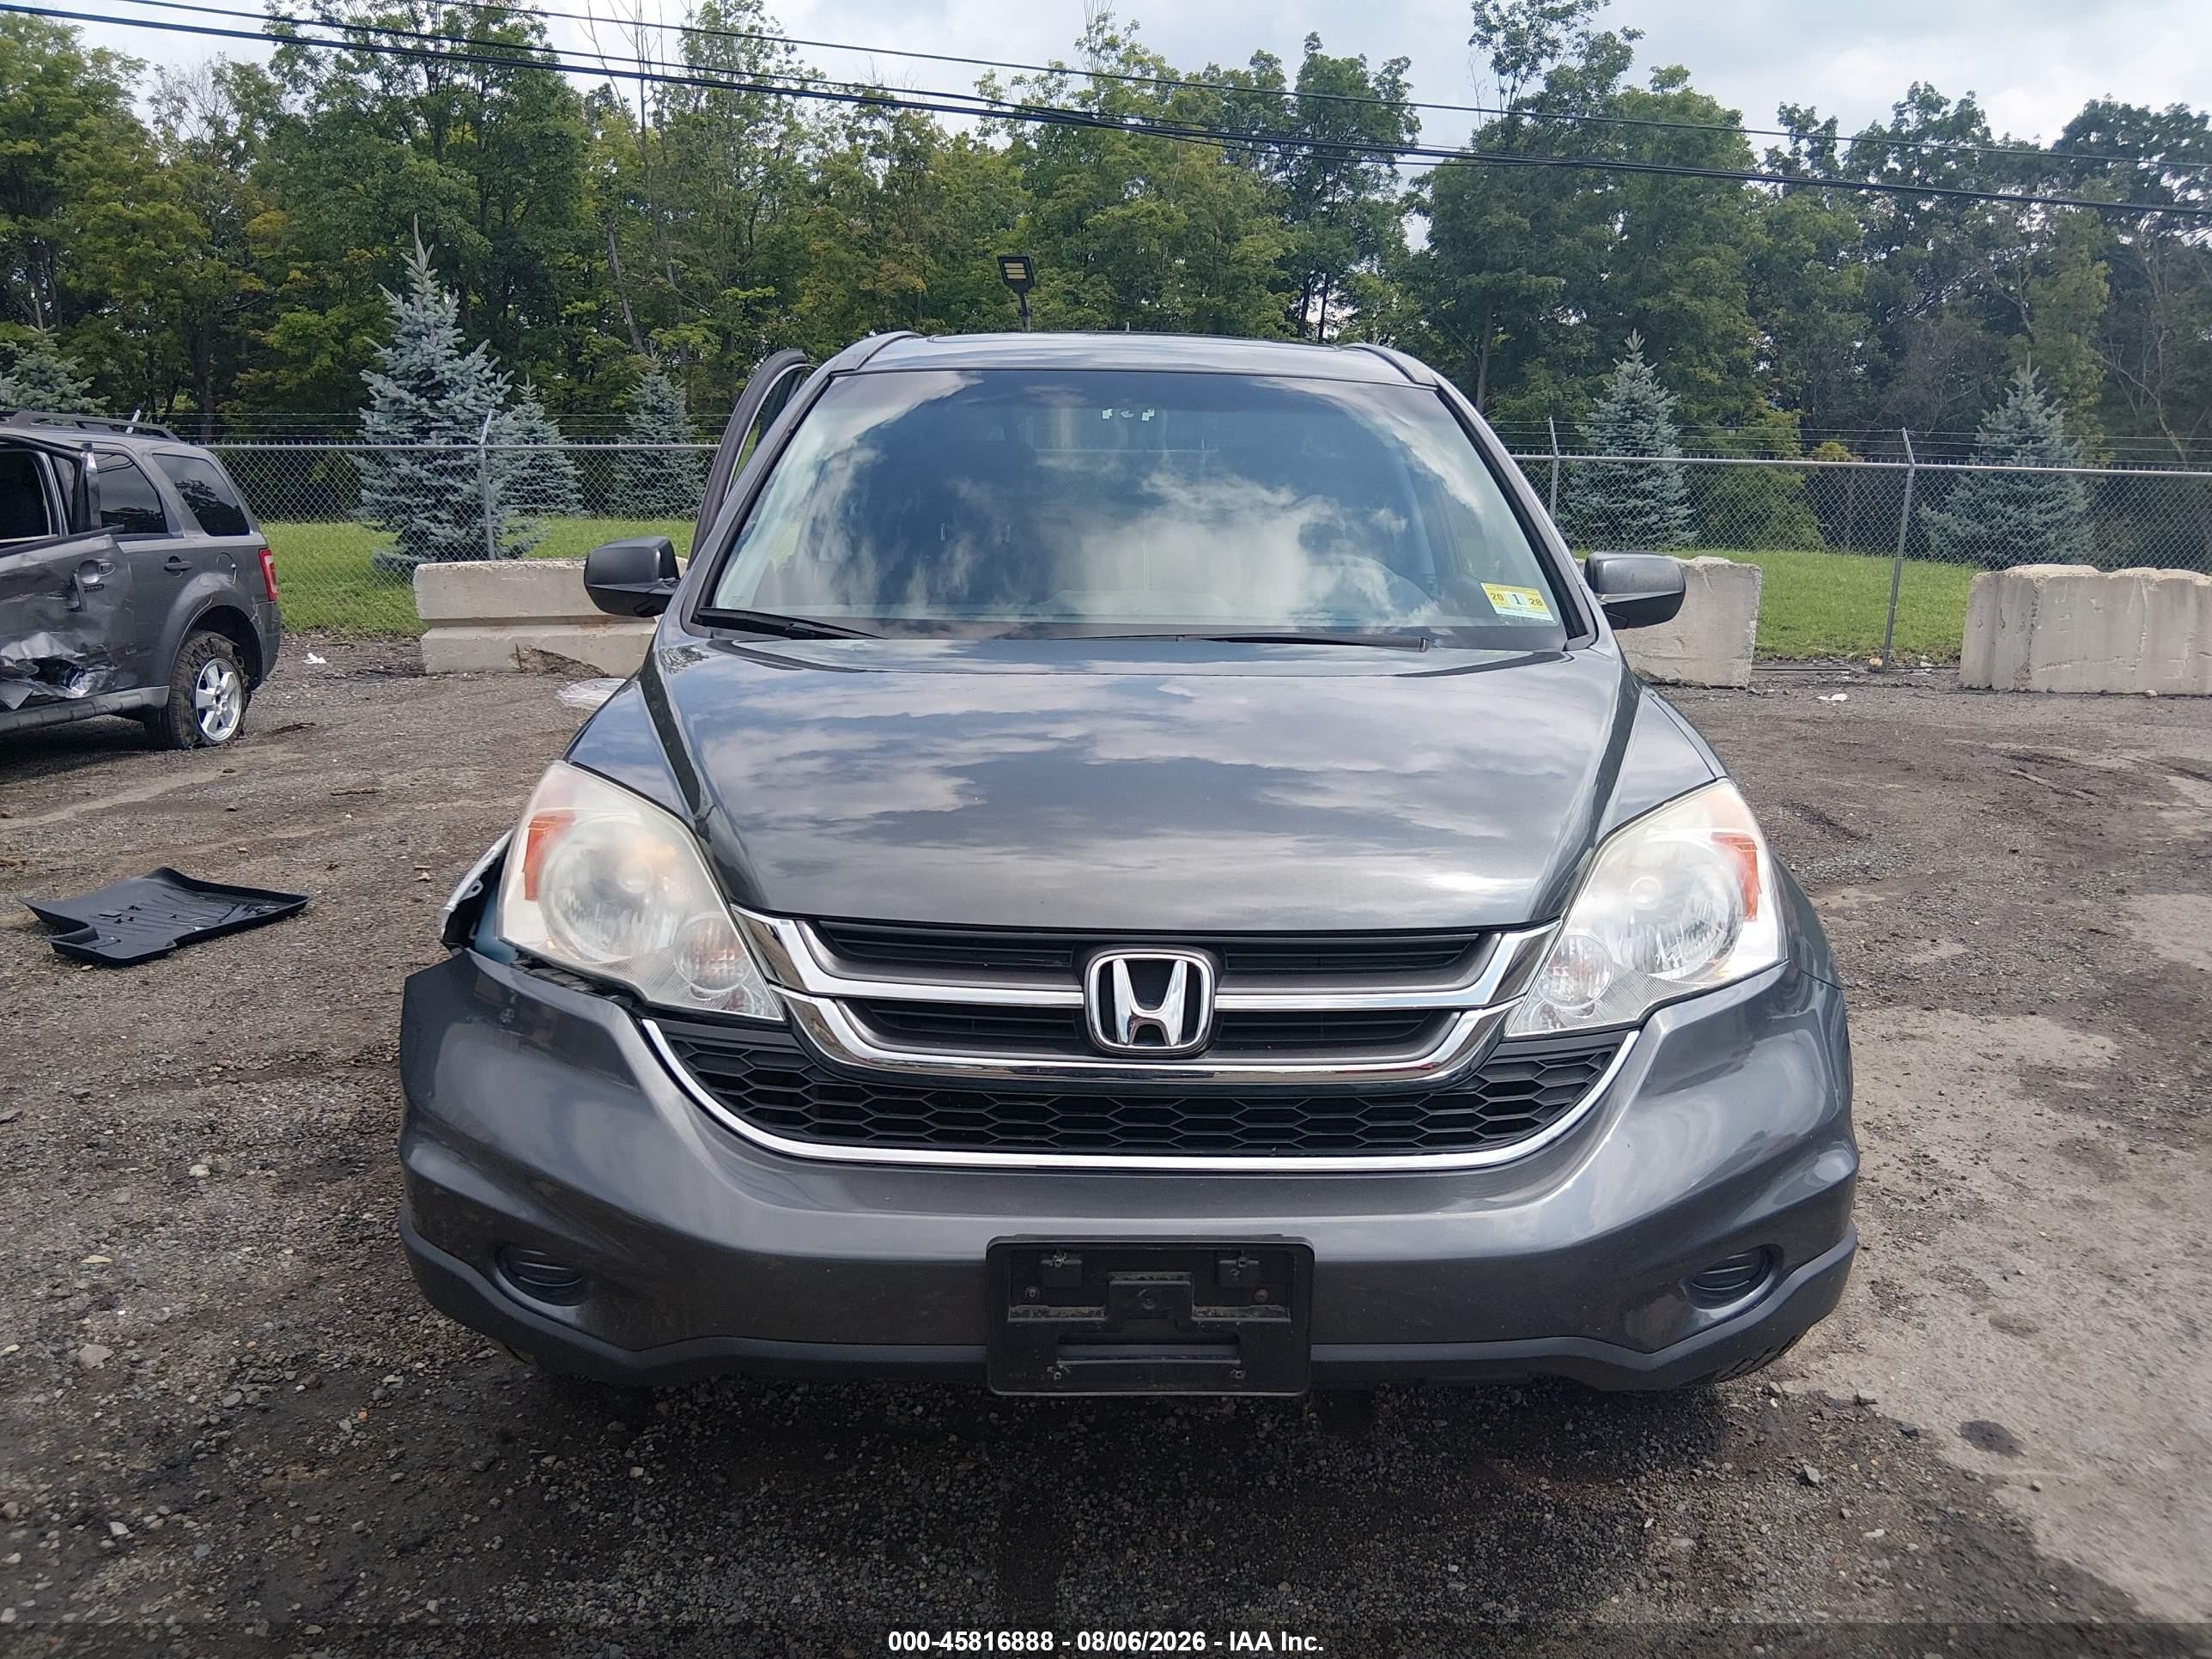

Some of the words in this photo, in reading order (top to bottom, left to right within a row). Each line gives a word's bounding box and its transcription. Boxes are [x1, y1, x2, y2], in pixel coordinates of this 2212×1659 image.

[1490, 592, 1504, 601] 20
[1511, 593, 1523, 605] 1
[1528, 598, 1543, 606] 28
